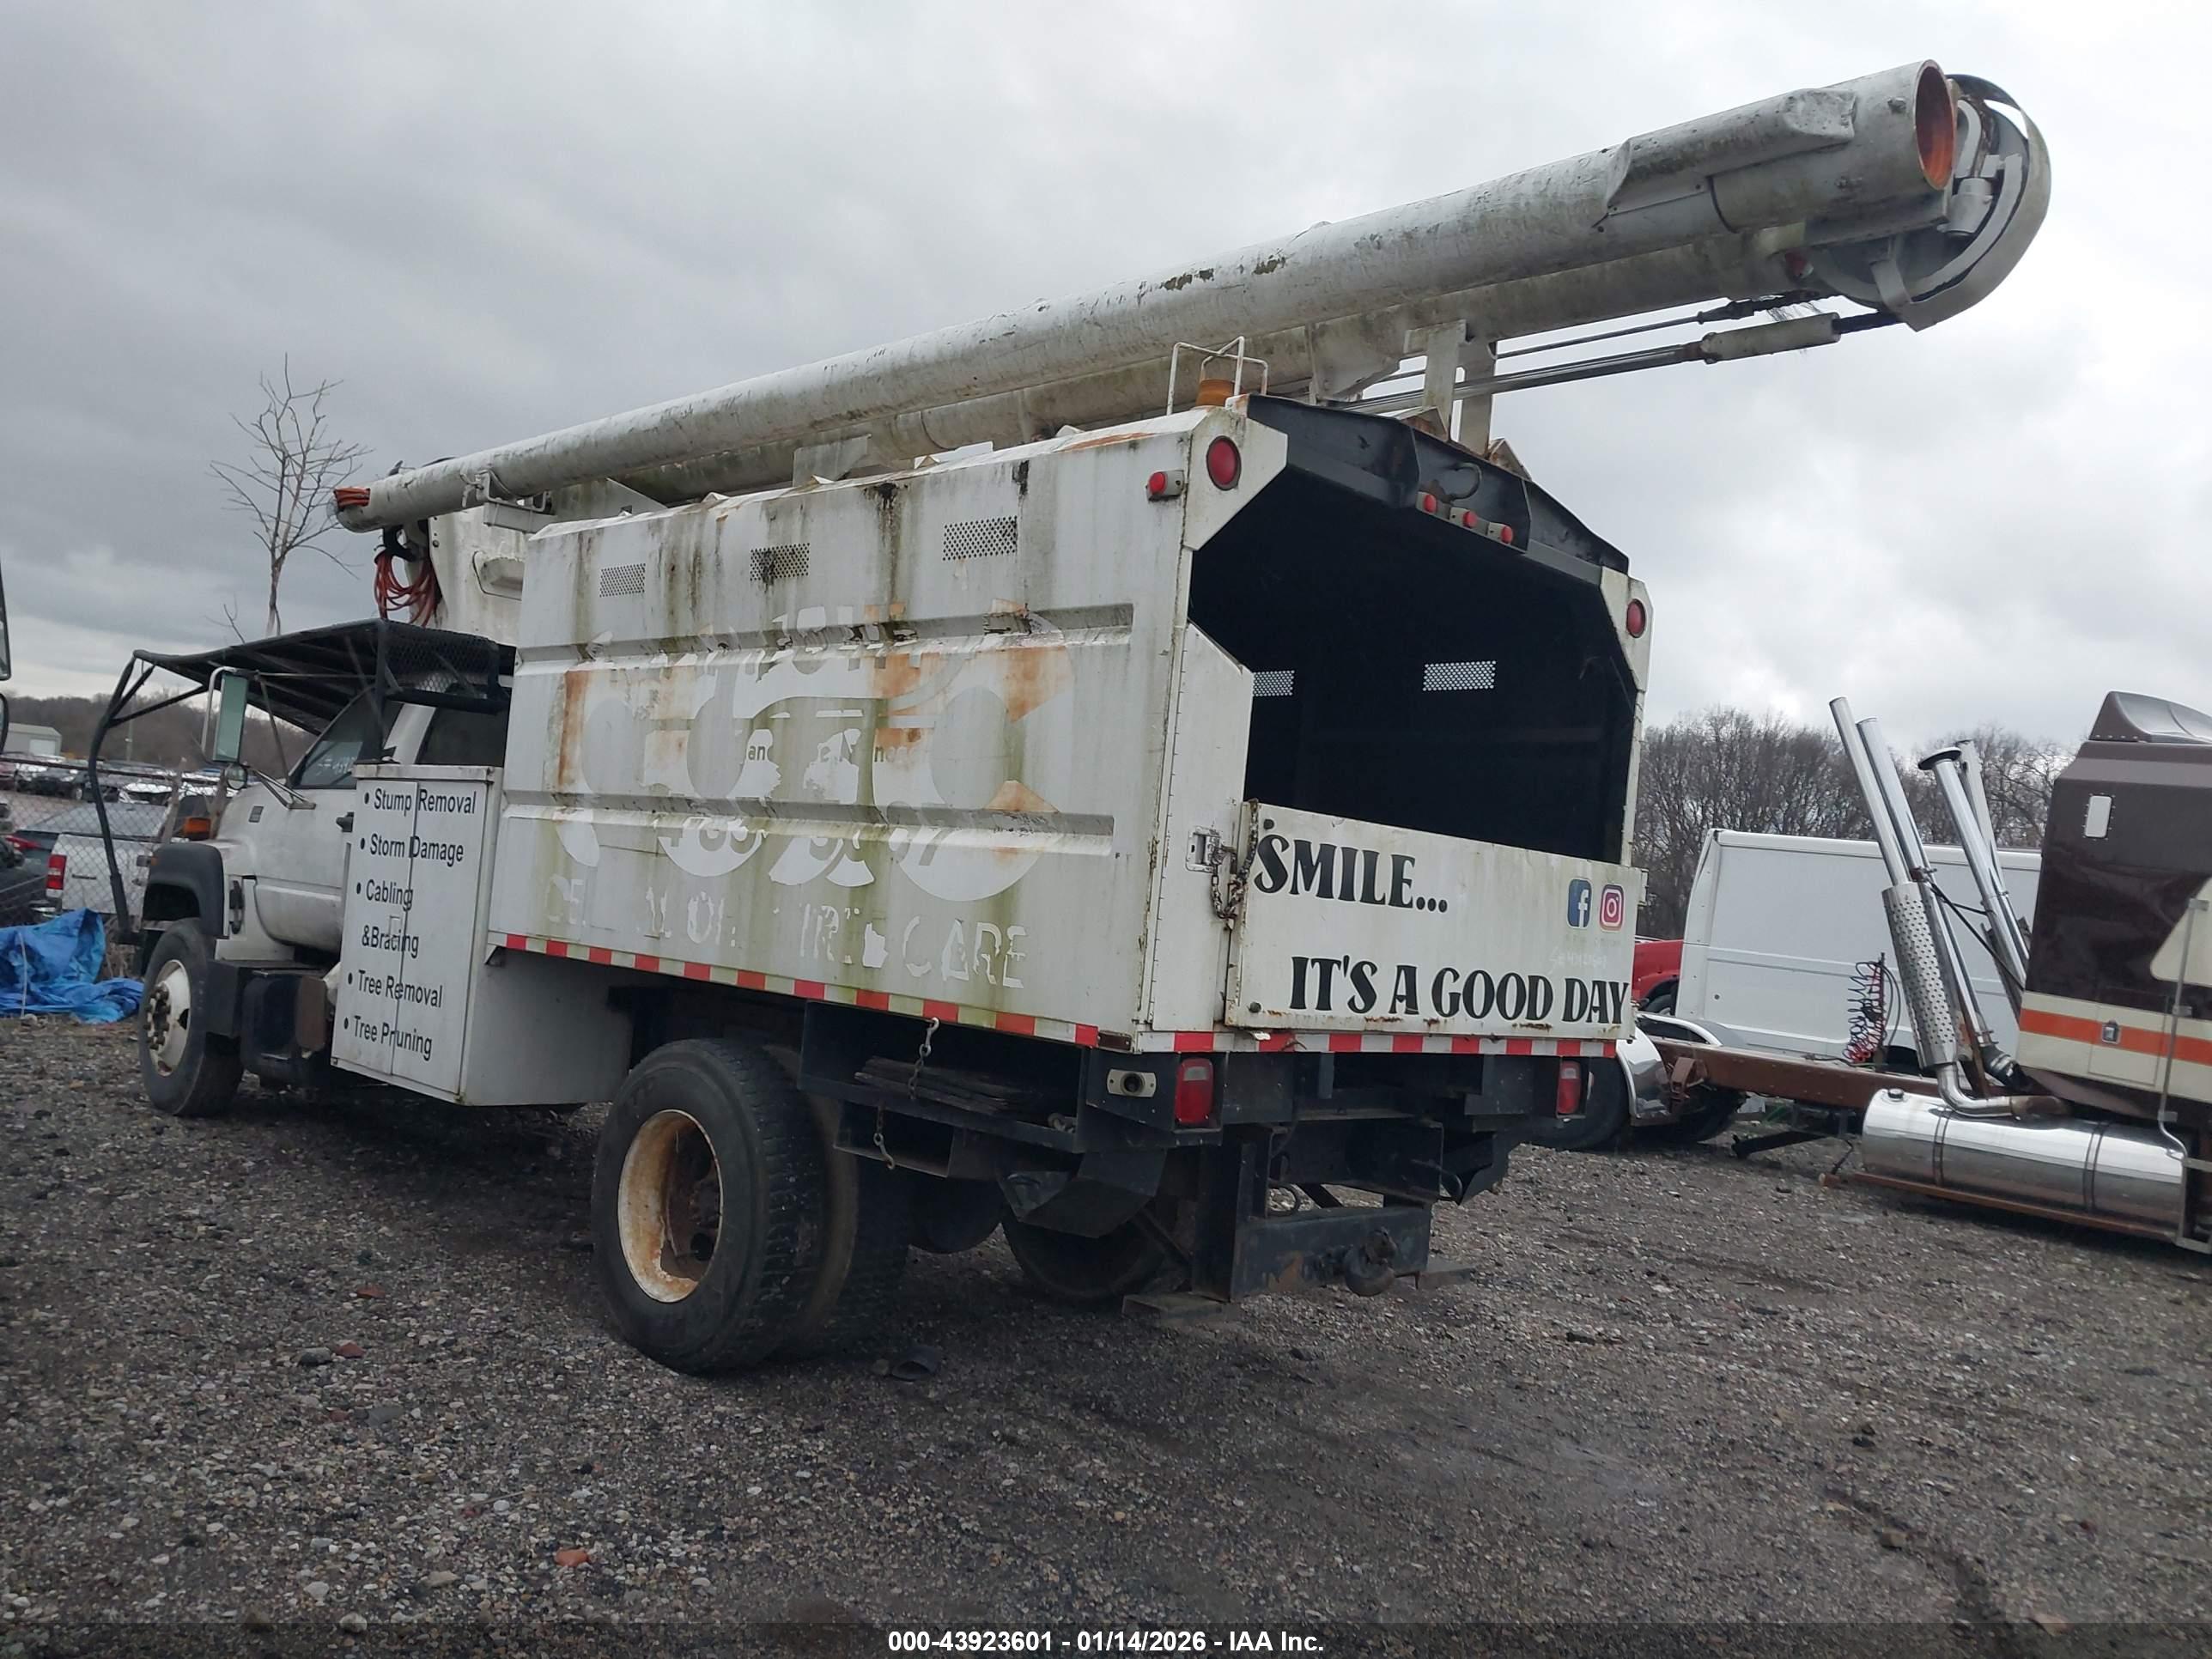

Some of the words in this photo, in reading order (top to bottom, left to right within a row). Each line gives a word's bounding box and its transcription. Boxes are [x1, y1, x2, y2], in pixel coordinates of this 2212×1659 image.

[374, 787, 413, 817] Stump
[418, 788, 477, 815] Removal
[369, 833, 405, 858] Storm
[410, 835, 465, 867] Damage
[1253, 833, 1449, 915] SMILE...
[365, 878, 414, 912] Cabling
[361, 924, 420, 958] &Bracing
[358, 969, 382, 995] Tree
[386, 975, 443, 1007] Removal
[1289, 954, 1378, 1015] IT'S
[1389, 964, 1420, 1016] A
[1431, 966, 1554, 1021] GOOD
[1561, 977, 1630, 1025] DAY
[354, 1015, 378, 1042] Tree
[380, 1022, 432, 1061] Pruning
